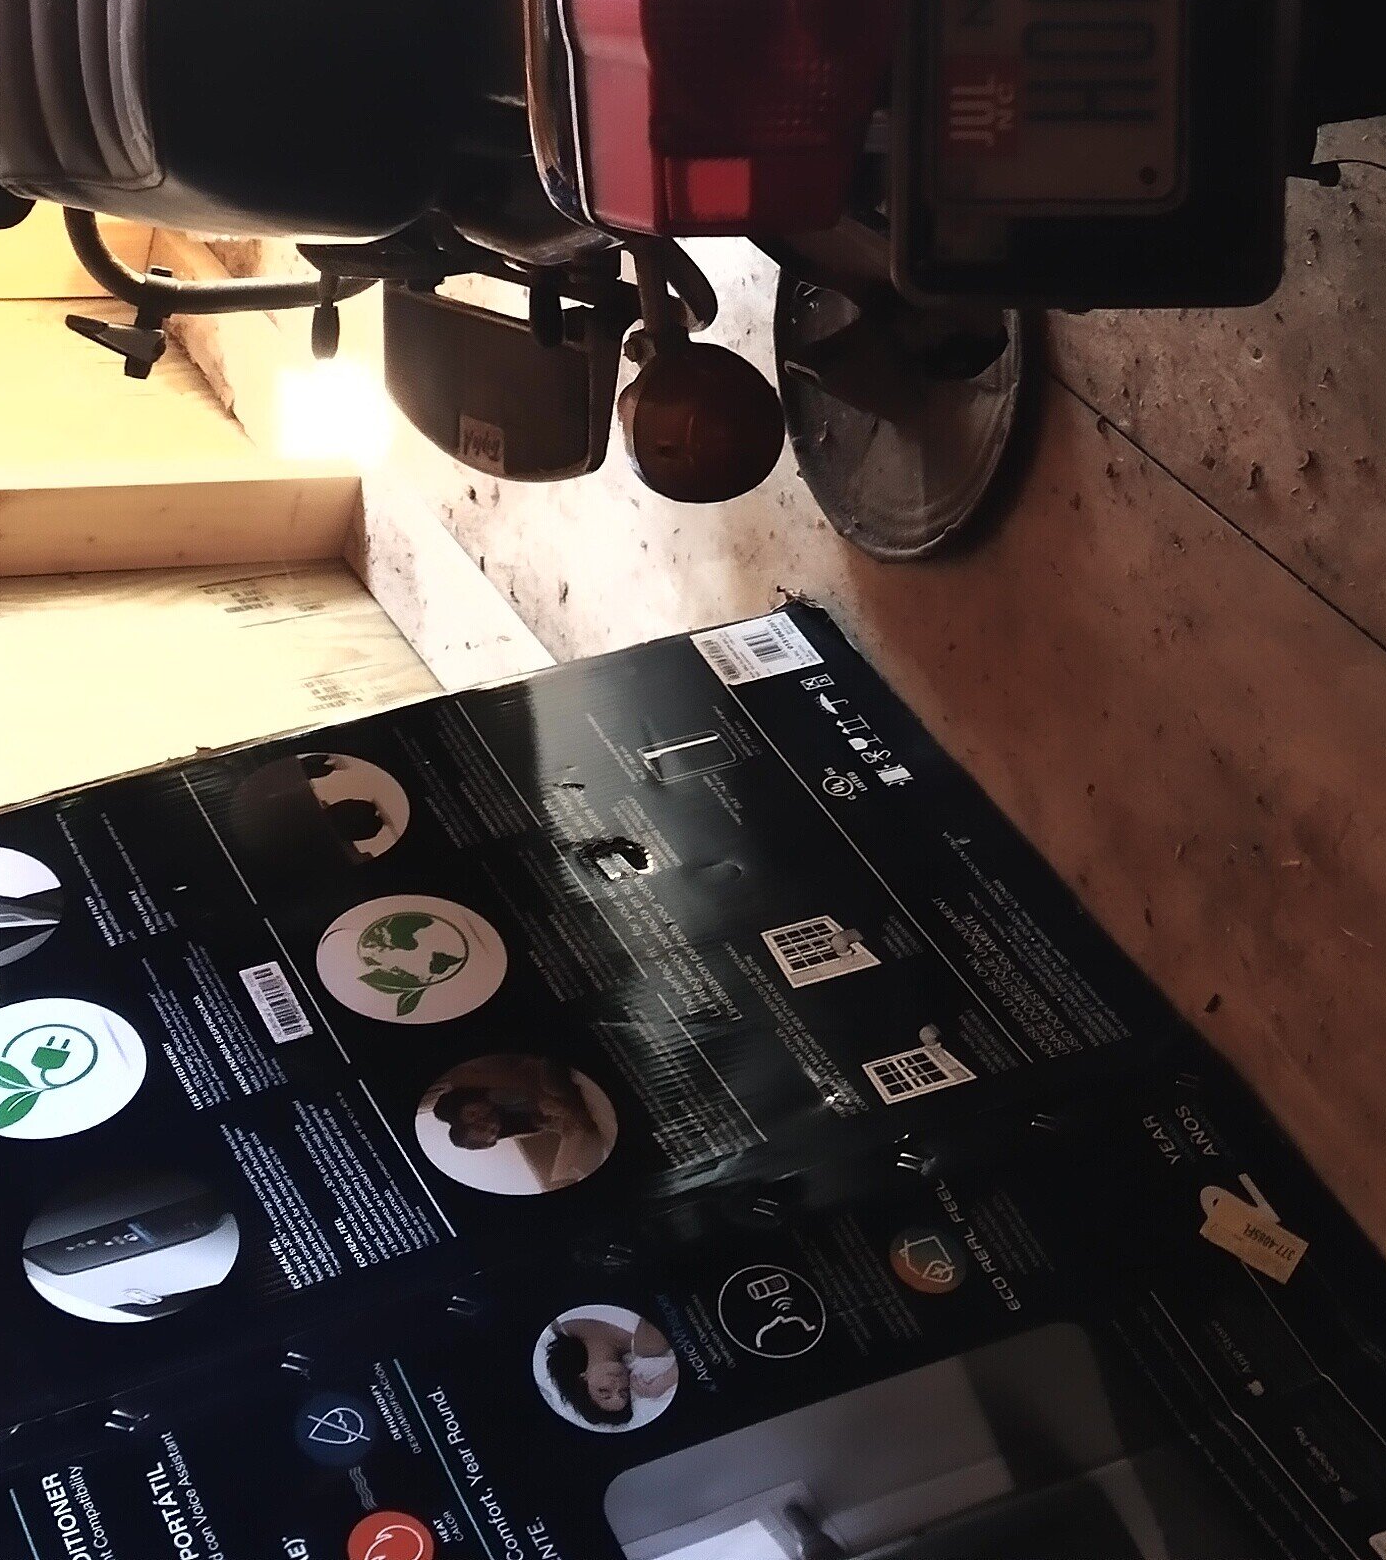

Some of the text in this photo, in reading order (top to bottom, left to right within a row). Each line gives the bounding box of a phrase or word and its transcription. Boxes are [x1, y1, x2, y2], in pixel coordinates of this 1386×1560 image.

[948, 72, 997, 147] JUL
[962, 914, 1015, 972] SOLAMENTE
[964, 953, 1057, 1058] HOUSEHOLD USE ONLY
[983, 958, 1042, 1021] DOMESTIQUE
[1037, 1021, 1071, 1055] USAGE
[1060, 1030, 1084, 1052] USO
[161, 1042, 204, 1111] LESS WASTED ENERGY
[1143, 1115, 1181, 1165] YEAR
[1175, 1105, 1219, 1156] AÑOS
[269, 1237, 303, 1290] ECO REAL FEEL
[334, 1217, 368, 1268] ECO REAL FEEL
[936, 1179, 1021, 1311] ECO REAL FEEL
[370, 1385, 402, 1441] DEHUMIDIFY
[161, 1431, 219, 1551] con Voice Assistant
[427, 1386, 524, 1560] Comfort, Year Round.
[69, 1466, 108, 1548] Compatibility
[147, 1462, 199, 1560] PORTÁTIL
[433, 1519, 451, 1543] HEAT
[443, 1510, 464, 1542] CALOR
